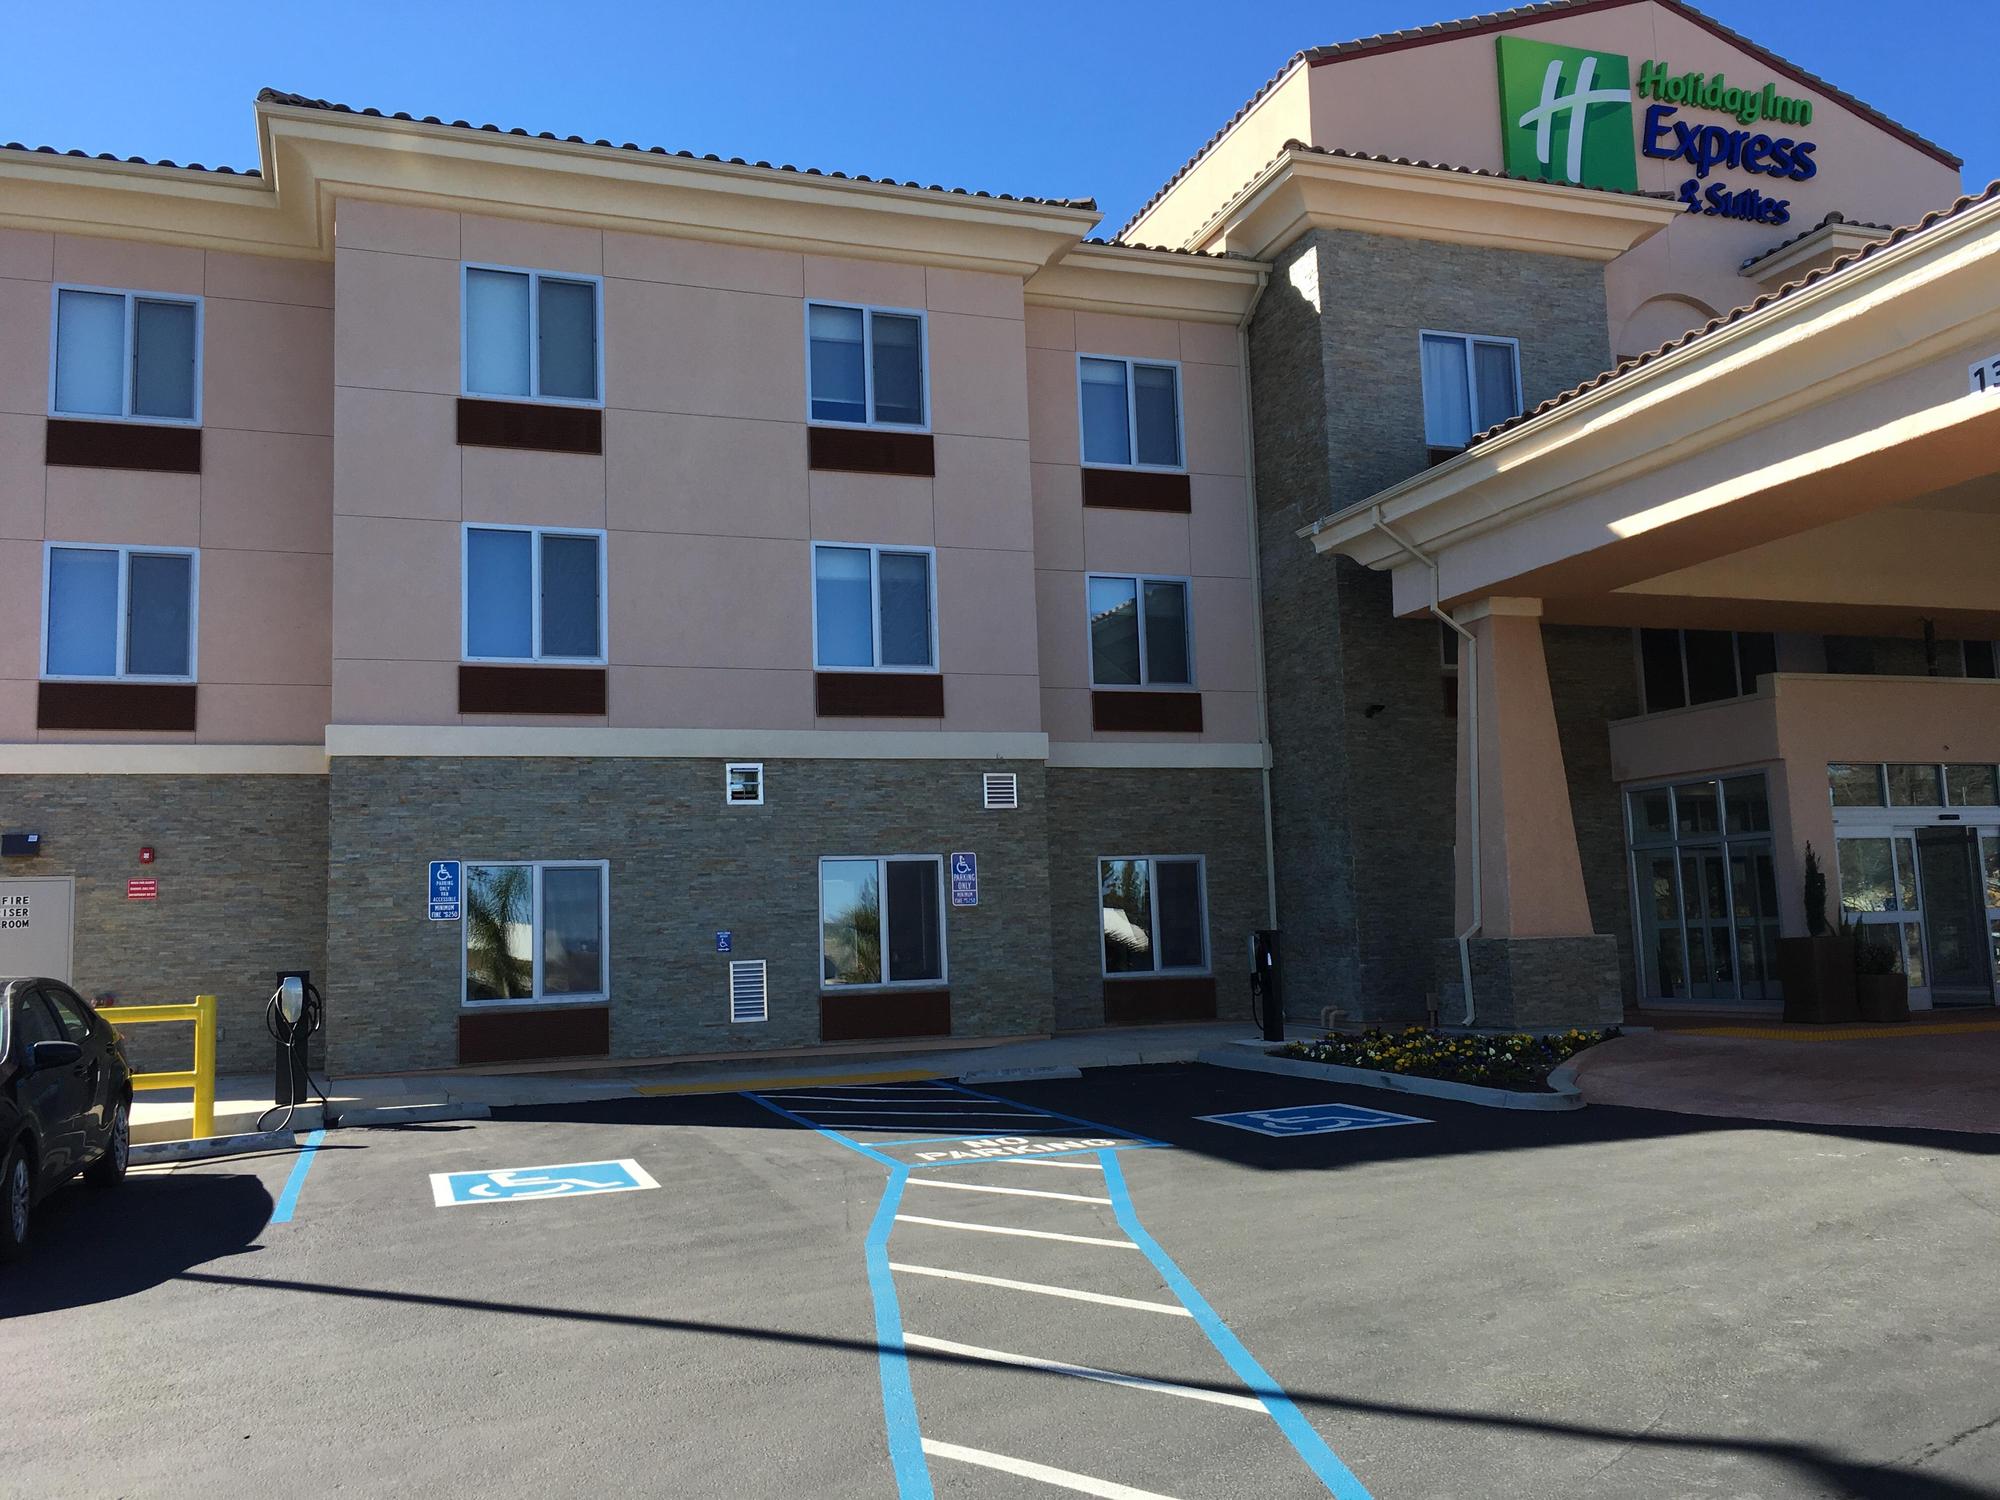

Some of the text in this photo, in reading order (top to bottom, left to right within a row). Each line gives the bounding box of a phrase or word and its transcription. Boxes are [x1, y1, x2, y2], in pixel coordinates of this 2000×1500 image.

[1637, 59, 1813, 127] Holiday Inn
[1642, 103, 1818, 182] Express
[1703, 182, 1791, 226] Suites
[953, 873, 976, 882] PARKING
[957, 882, 972, 890] ONLY
[2, 896, 30, 905] FIRE
[0, 908, 29, 917] ISER
[1, 919, 30, 929] ROOM
[963, 1136, 1030, 1149] NO
[915, 1138, 1117, 1161] PARKING
